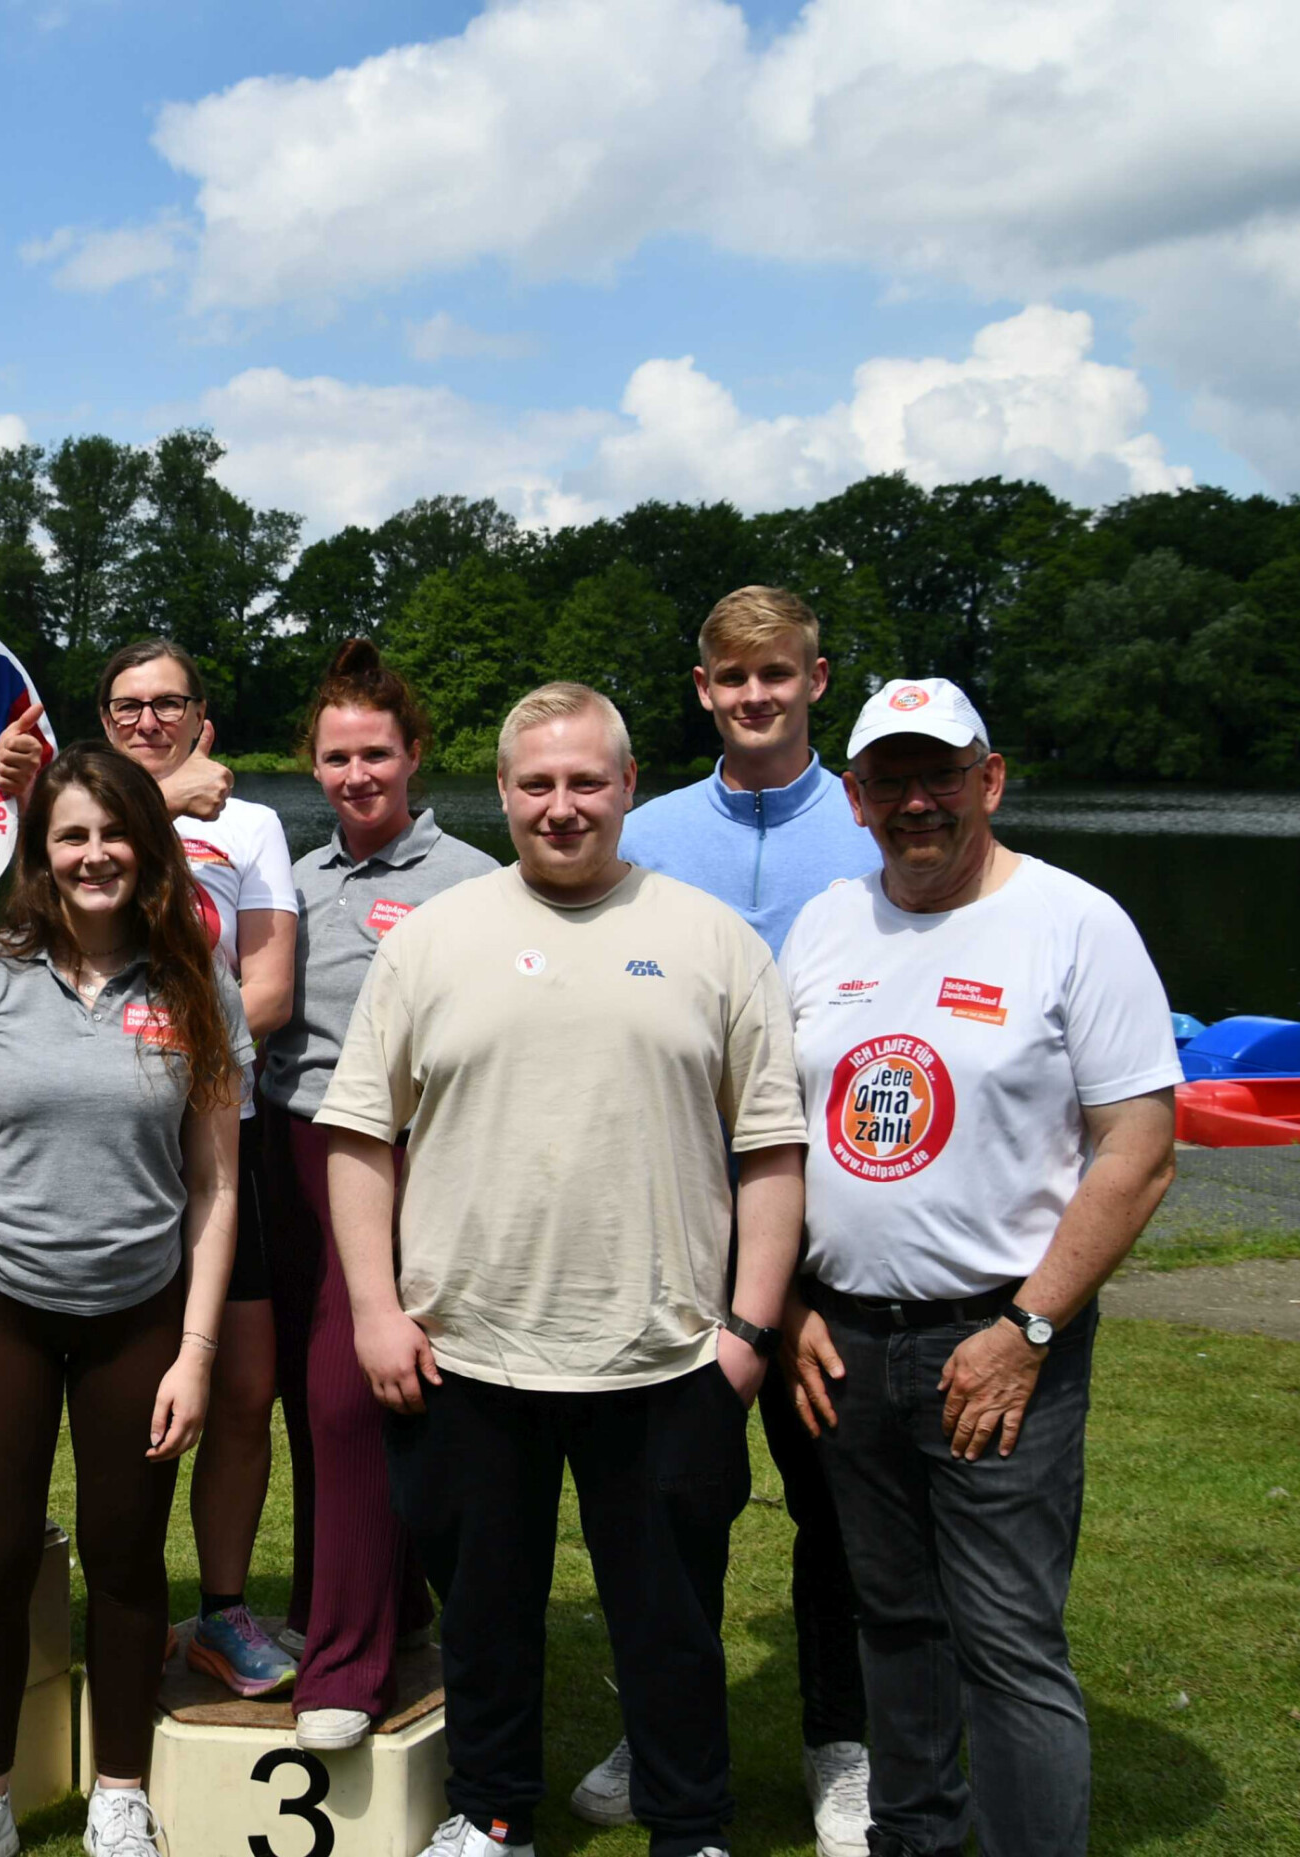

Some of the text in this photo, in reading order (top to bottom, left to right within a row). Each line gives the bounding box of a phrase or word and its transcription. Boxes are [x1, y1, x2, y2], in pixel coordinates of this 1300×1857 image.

[374, 903, 408, 915] HelpAge
[941, 990, 998, 1006] Deutschland
[944, 981, 982, 993] HelpAge
[849, 1046, 874, 1068] ICH
[874, 1038, 914, 1055] LAUFE
[912, 1044, 935, 1069] FÜR
[872, 1067, 913, 1087] Jede
[854, 1084, 910, 1114] Oma
[855, 1116, 912, 1144] zählt
[834, 1142, 930, 1179] www.helpage.de
[247, 1747, 335, 1857] 3
